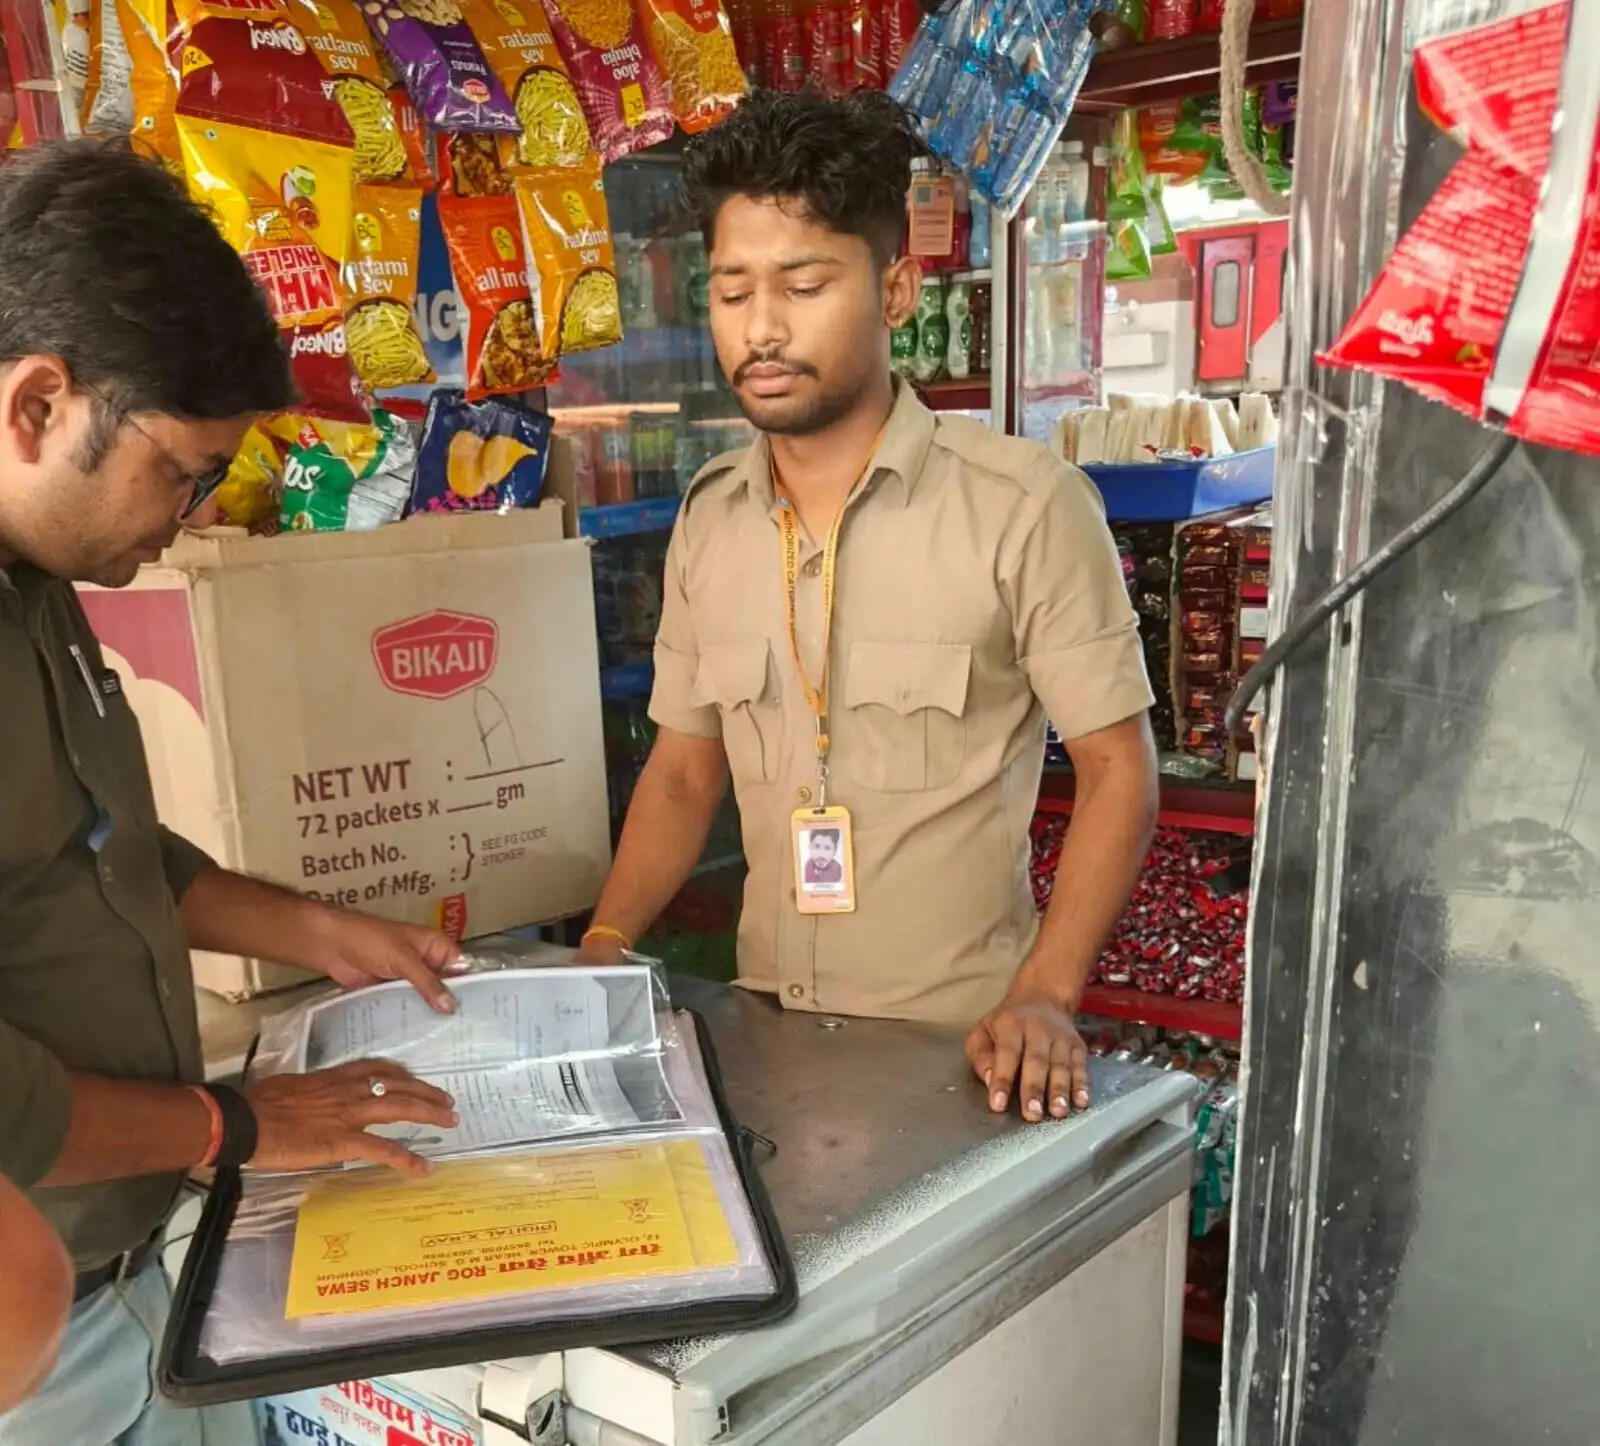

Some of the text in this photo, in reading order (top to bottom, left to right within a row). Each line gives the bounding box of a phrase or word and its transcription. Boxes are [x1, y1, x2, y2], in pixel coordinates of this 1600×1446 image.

[497, 28, 552, 49] ratlami
[328, 54, 359, 71] sev
[600, 43, 642, 67] bhujia
[612, 62, 640, 80] aloo
[362, 277, 394, 294] sev
[391, 640, 486, 681] BIKAJI
[292, 758, 412, 805] NET WT
[297, 814, 329, 839] 72
[336, 800, 423, 839] packets
[496, 782, 526, 810] gm
[301, 842, 407, 878] Batch No.
[364, 878, 387, 900] of
[391, 870, 436, 896] Mfg.
[580, 1235, 641, 1251] OLYMPIC
[484, 1250, 522, 1263] NEAR
[315, 1267, 383, 1282] JODHPUR
[315, 1266, 487, 1298] ROG JANCH SEWA
